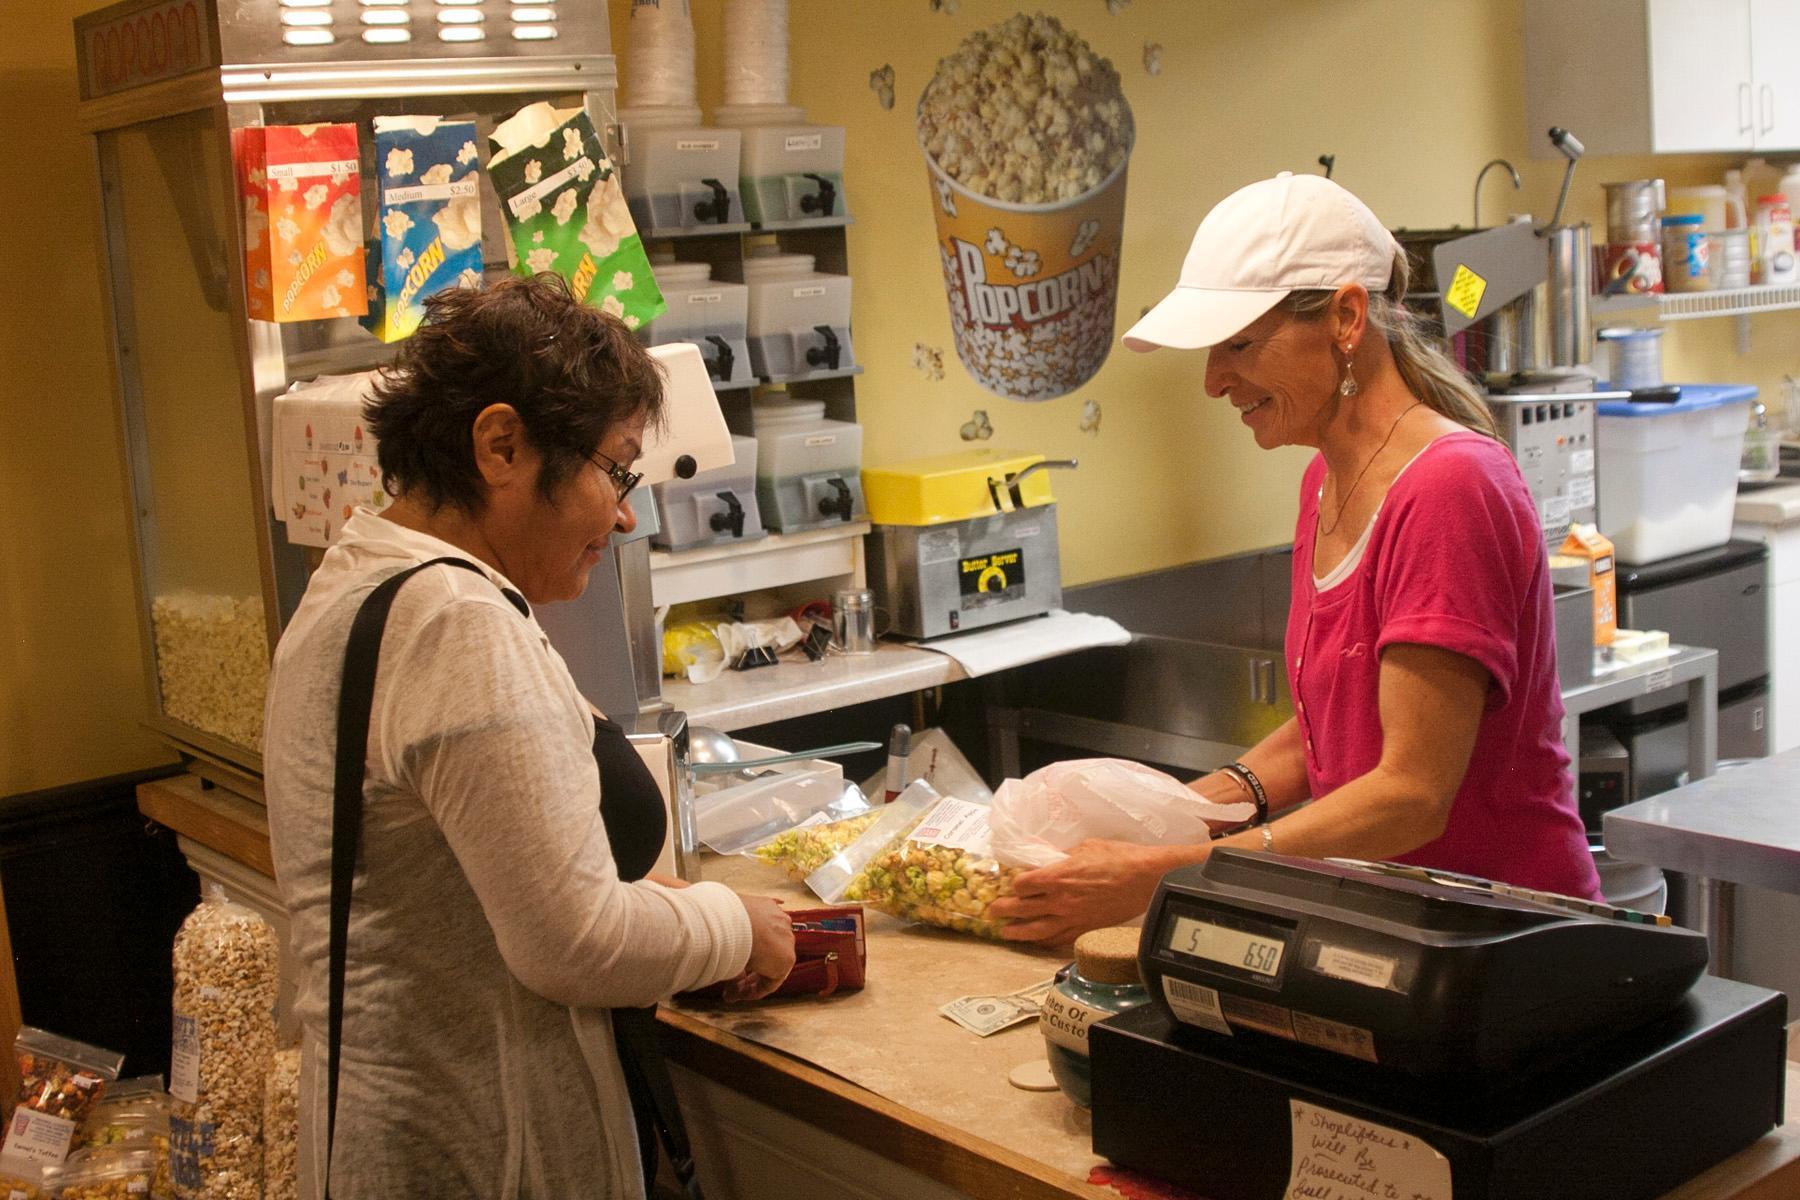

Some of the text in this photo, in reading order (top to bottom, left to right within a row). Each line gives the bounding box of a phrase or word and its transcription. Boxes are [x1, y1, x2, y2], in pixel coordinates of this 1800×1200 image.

[271, 162, 358, 177] Small $1.50
[388, 185, 476, 202] Medium $2.50
[513, 160, 589, 209] Large $3.50
[282, 241, 329, 313] POPCORN
[391, 235, 448, 329] POPCORN
[953, 237, 1106, 326] POPCORN
[962, 552, 1018, 573] Butter Server
[1068, 1006, 1088, 1022] Of
[1049, 1014, 1086, 1038] Custo
[1354, 1147, 1376, 1169] Be
